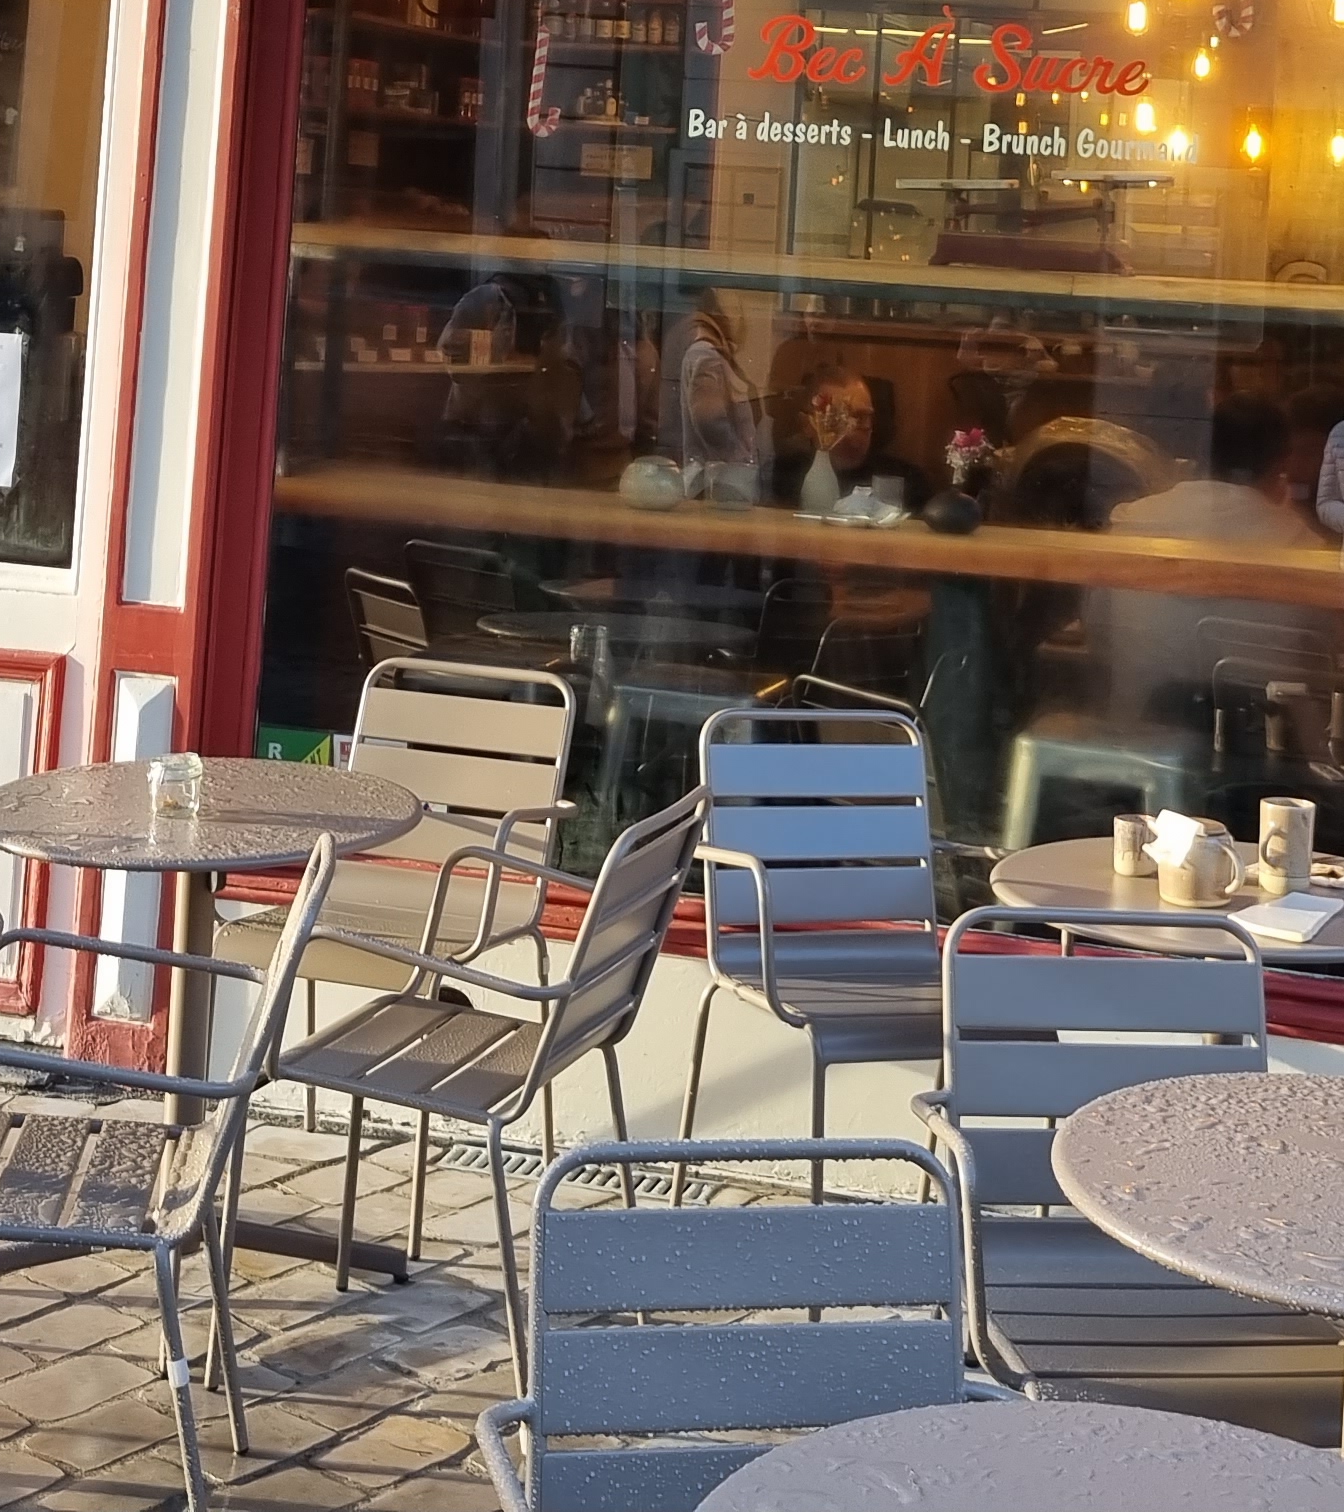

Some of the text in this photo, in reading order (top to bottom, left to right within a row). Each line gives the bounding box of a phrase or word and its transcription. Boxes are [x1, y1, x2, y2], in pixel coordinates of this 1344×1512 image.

[747, 5, 1150, 96] Bec À Sucre
[688, 108, 727, 140] Bar
[735, 113, 747, 140] à
[756, 114, 852, 147] desserts
[883, 119, 949, 151] Lunch
[983, 124, 1066, 157] Brunch
